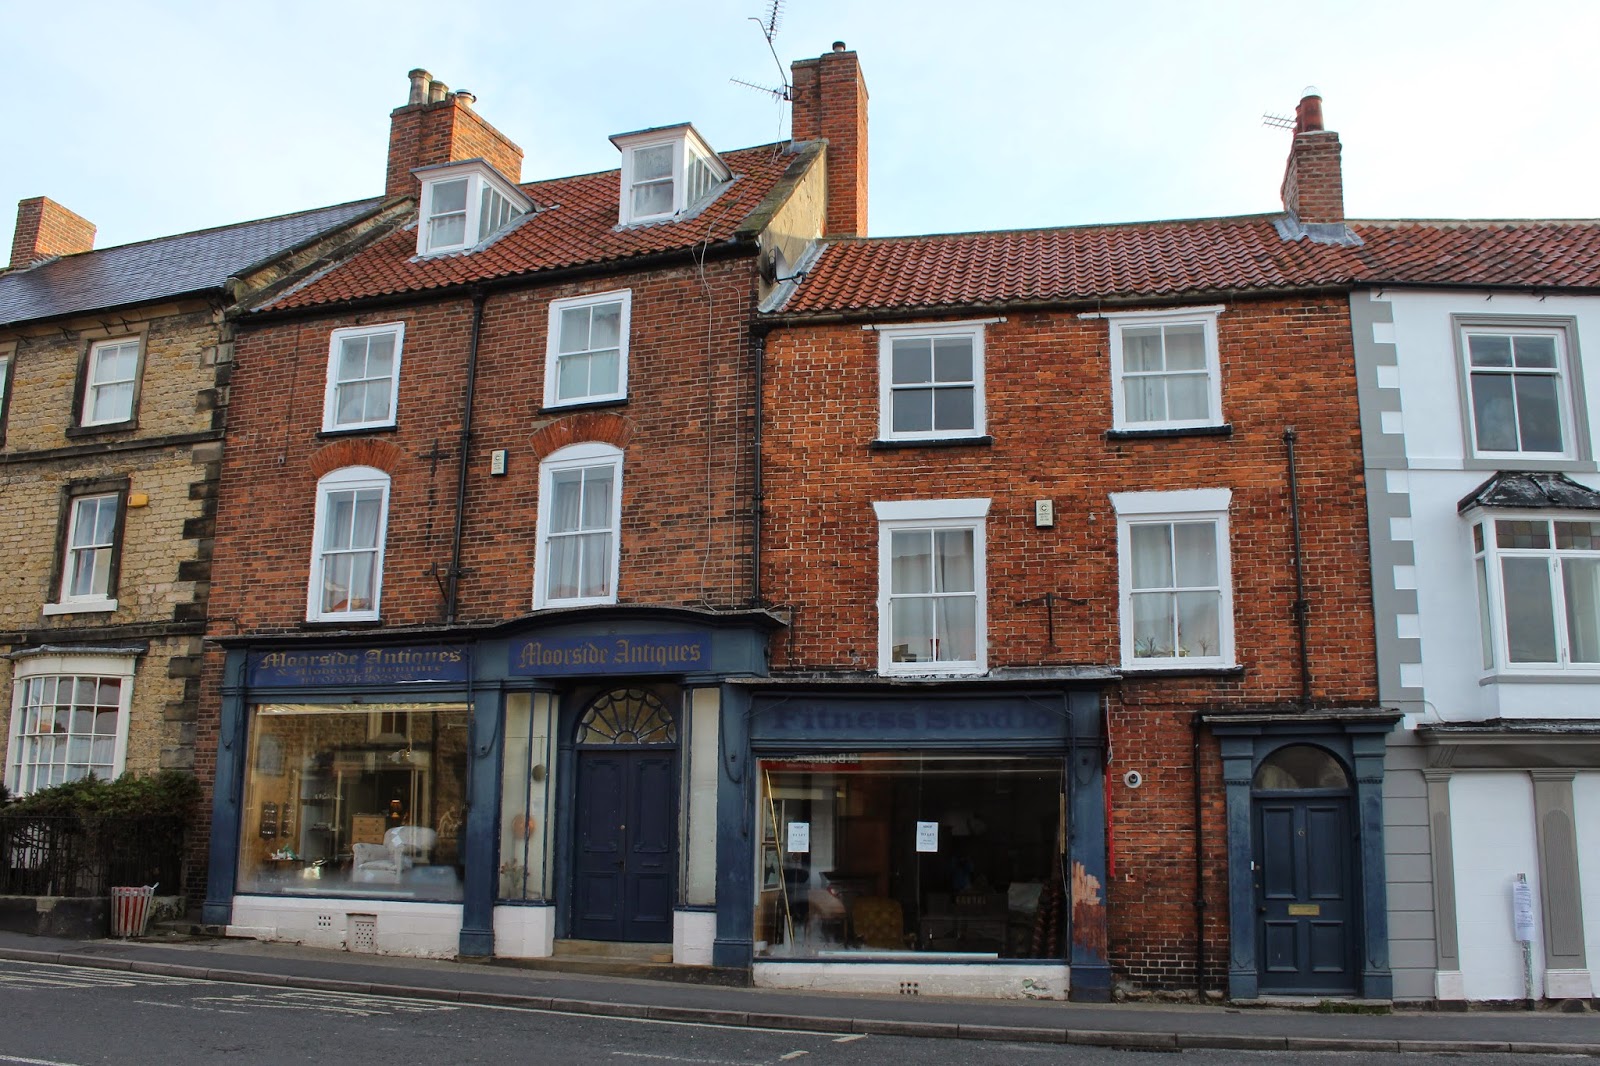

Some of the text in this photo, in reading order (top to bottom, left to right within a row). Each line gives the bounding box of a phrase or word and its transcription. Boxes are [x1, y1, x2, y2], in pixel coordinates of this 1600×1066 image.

[518, 640, 701, 668] Moorside Antiques
[773, 704, 917, 730] Fitness
